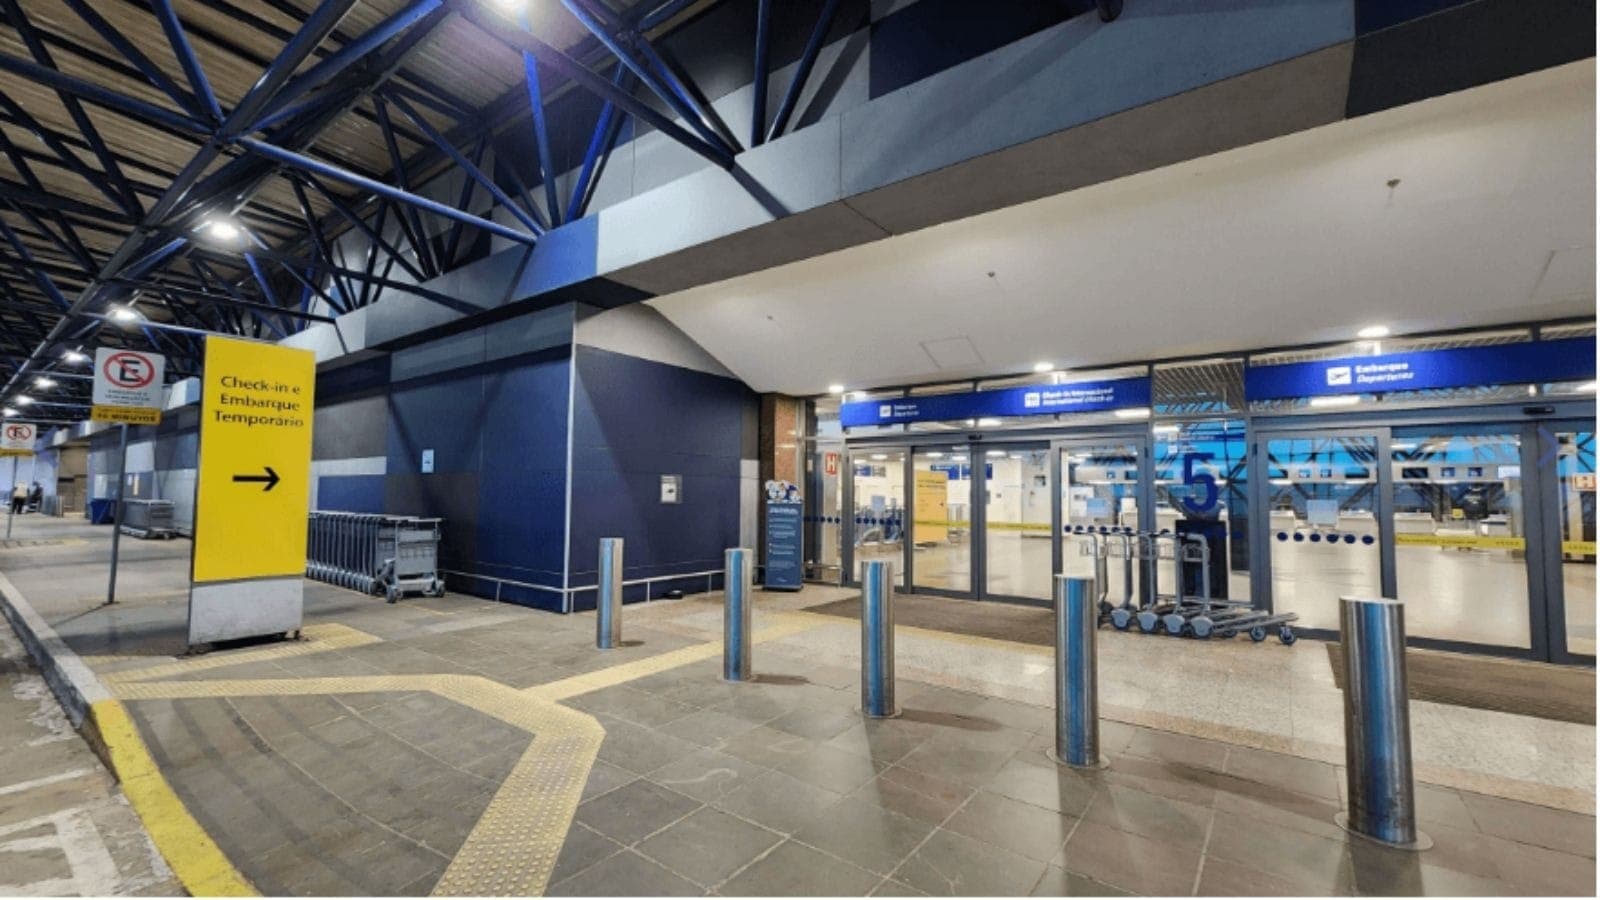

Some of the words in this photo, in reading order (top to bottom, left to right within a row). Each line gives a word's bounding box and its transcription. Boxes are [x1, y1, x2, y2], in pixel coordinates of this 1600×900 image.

[120, 359, 141, 382] E
[1356, 363, 1409, 374] Embarque
[220, 375, 289, 392] Check-in
[292, 386, 300, 394] e
[220, 393, 300, 412] Embarque
[214, 410, 304, 427] Temporário
[1183, 452, 1218, 513] 5
